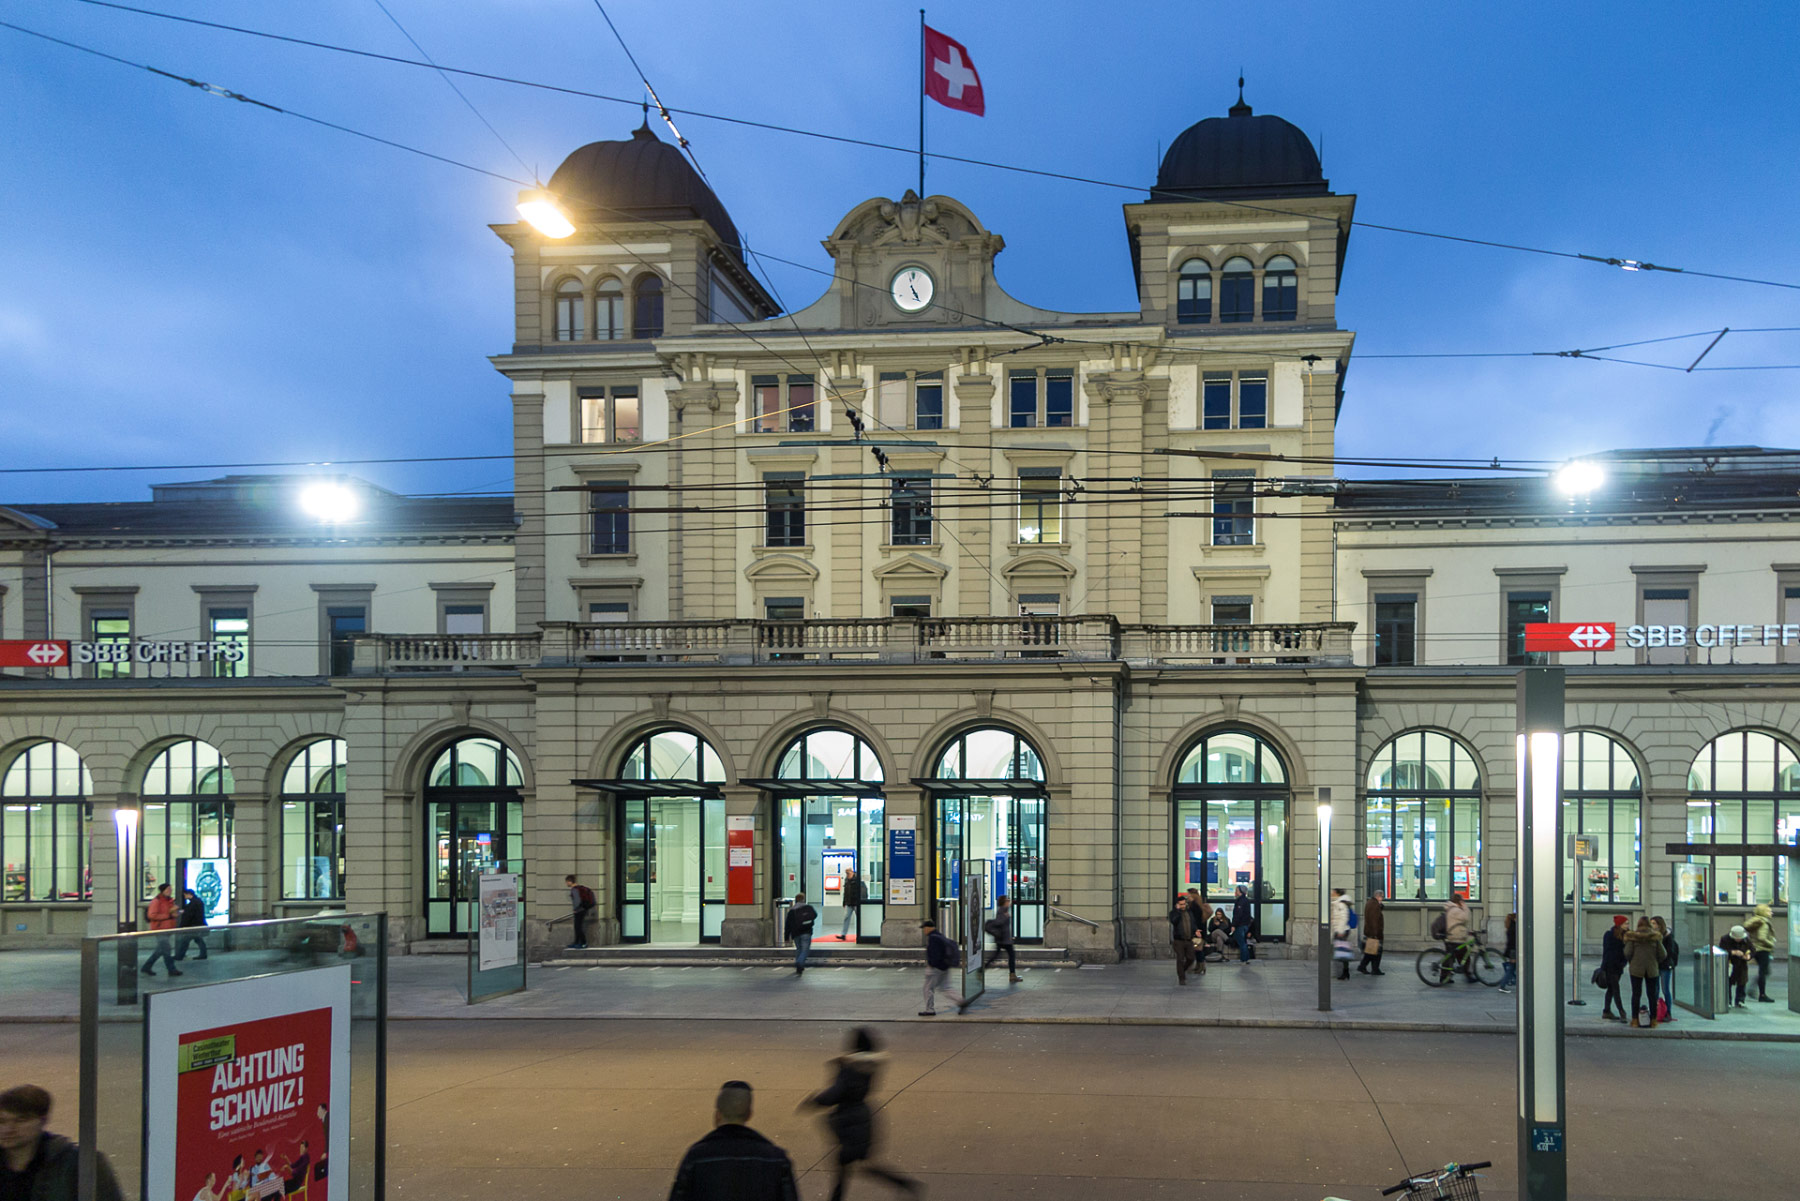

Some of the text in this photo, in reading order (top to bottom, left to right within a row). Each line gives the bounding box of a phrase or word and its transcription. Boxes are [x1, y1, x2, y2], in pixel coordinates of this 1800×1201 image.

[78, 641, 244, 663] SBB CFF FFS
[1626, 624, 1800, 648] SBB CFF FF
[211, 1043, 305, 1094] ACHTUNG
[210, 1076, 304, 1131] SCHWIIZ!
